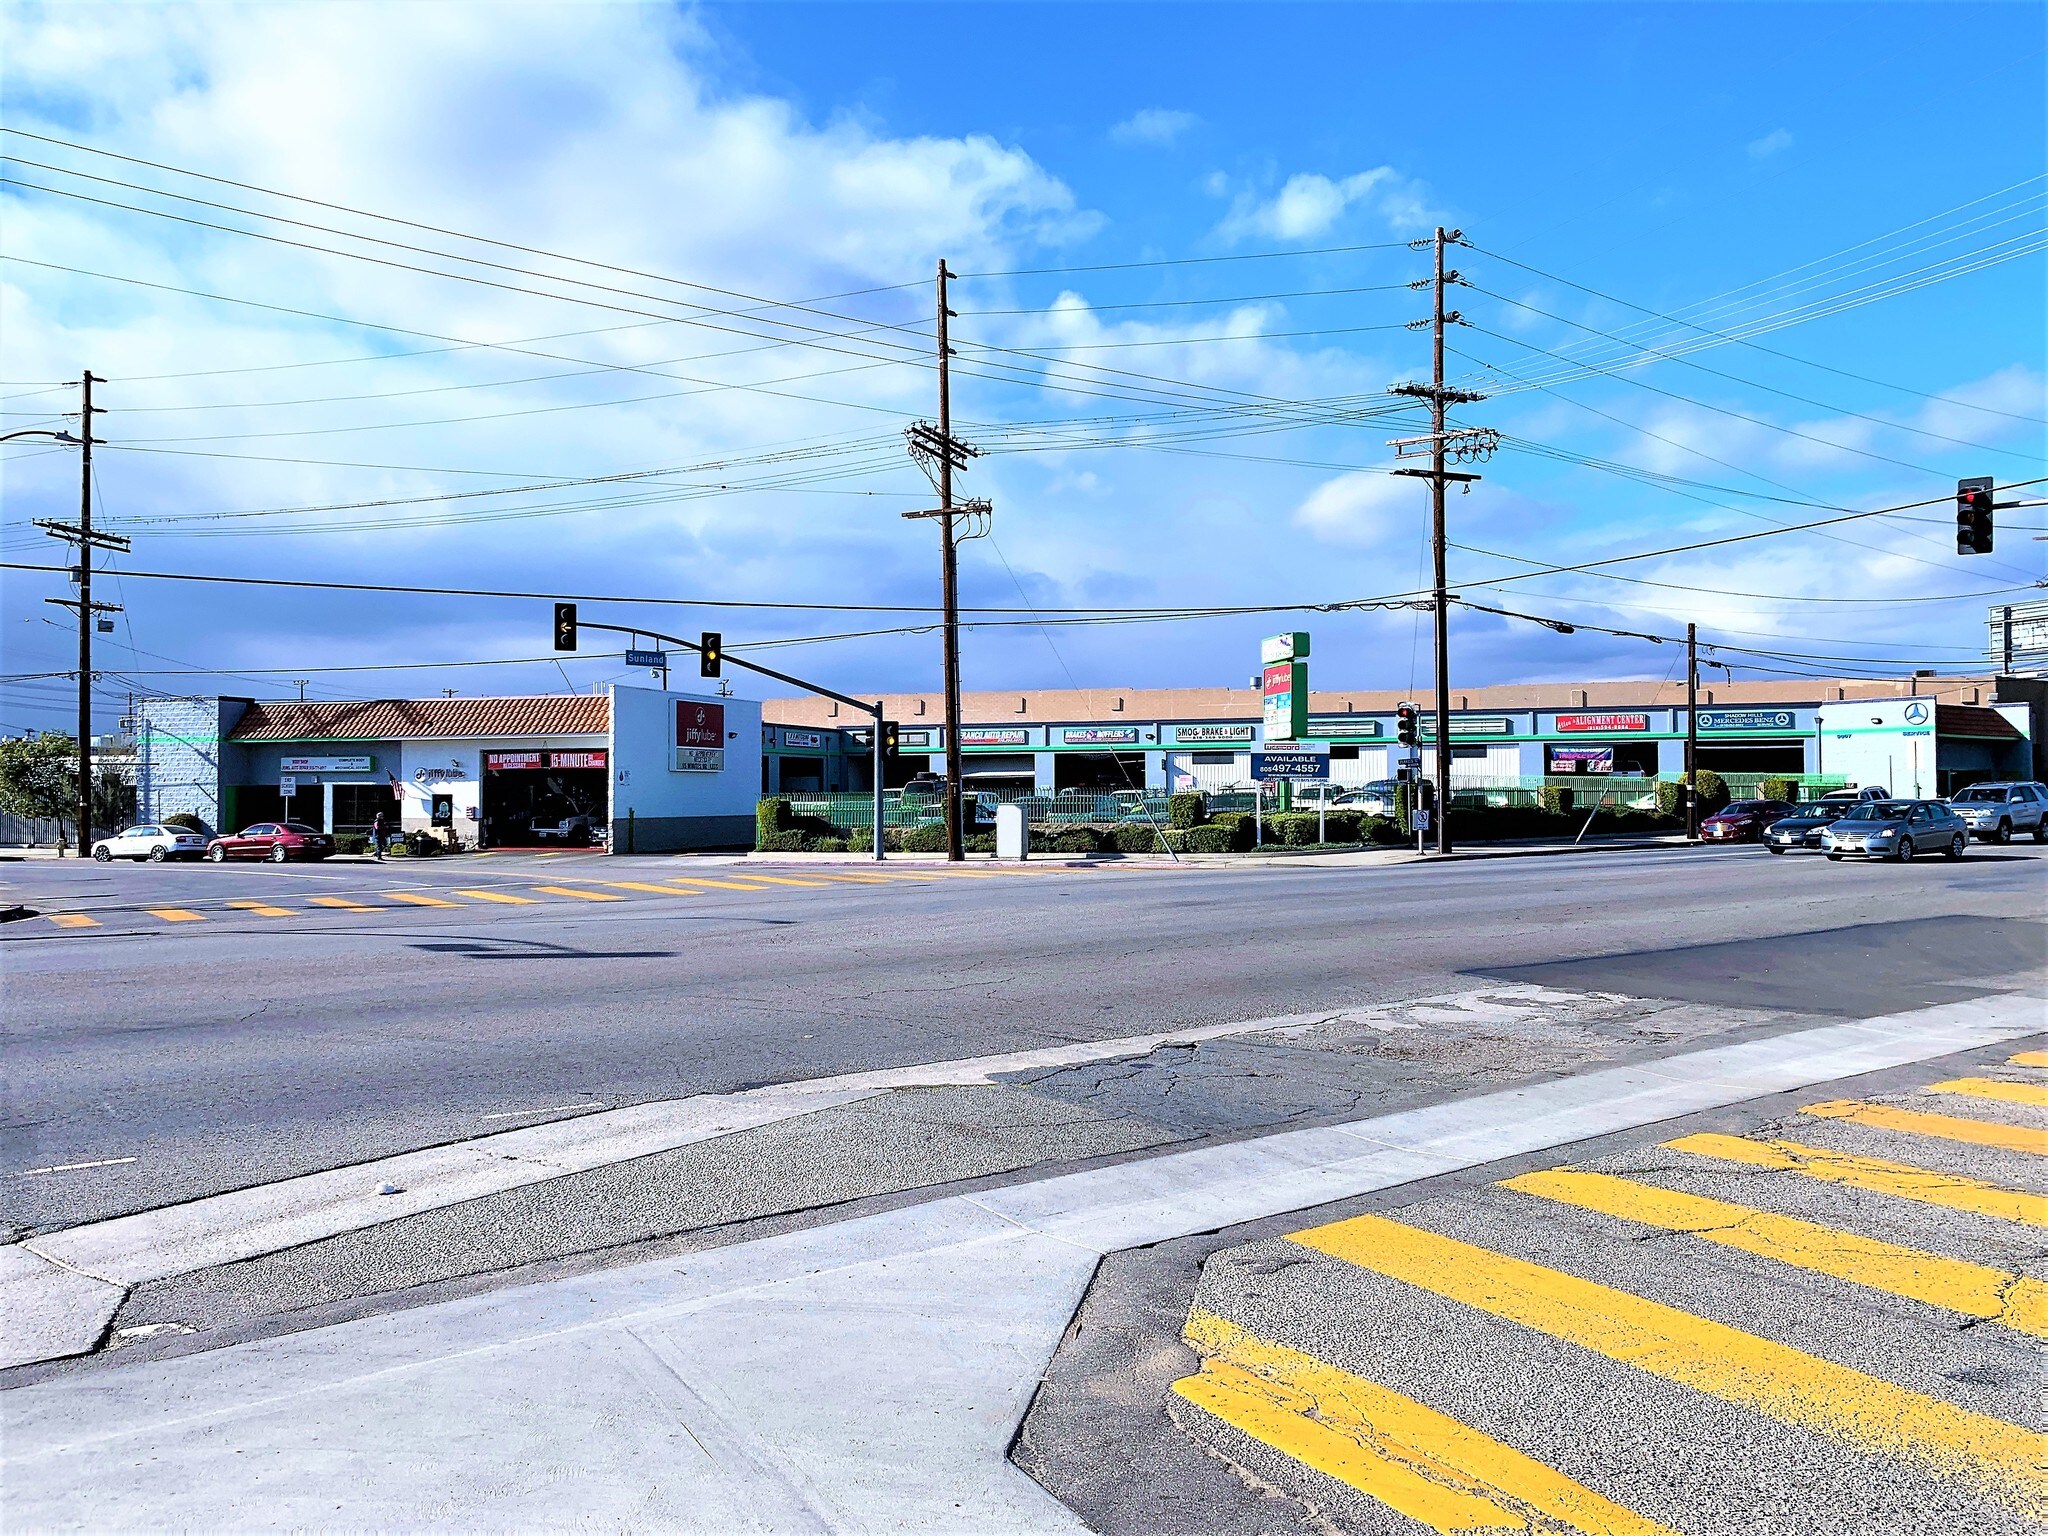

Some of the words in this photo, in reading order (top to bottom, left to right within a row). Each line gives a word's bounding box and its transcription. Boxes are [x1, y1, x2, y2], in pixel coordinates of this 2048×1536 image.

[628, 653, 664, 664] Sunland
[1575, 715, 1615, 725] ALIGNMENT
[1616, 714, 1645, 724] CENTER
[983, 731, 1000, 739] AUTO
[1001, 730, 1025, 738] REPAIR
[1096, 730, 1125, 738] MUFFLERS
[1177, 728, 1200, 736] SMOG
[1202, 727, 1223, 736] BRAKE
[1230, 727, 1249, 736] LIGHT
[489, 754, 498, 764] NO
[498, 753, 540, 763] APPOINTMENT
[551, 753, 589, 768] 15-MINUTE
[1272, 764, 1320, 773] 497-4557
